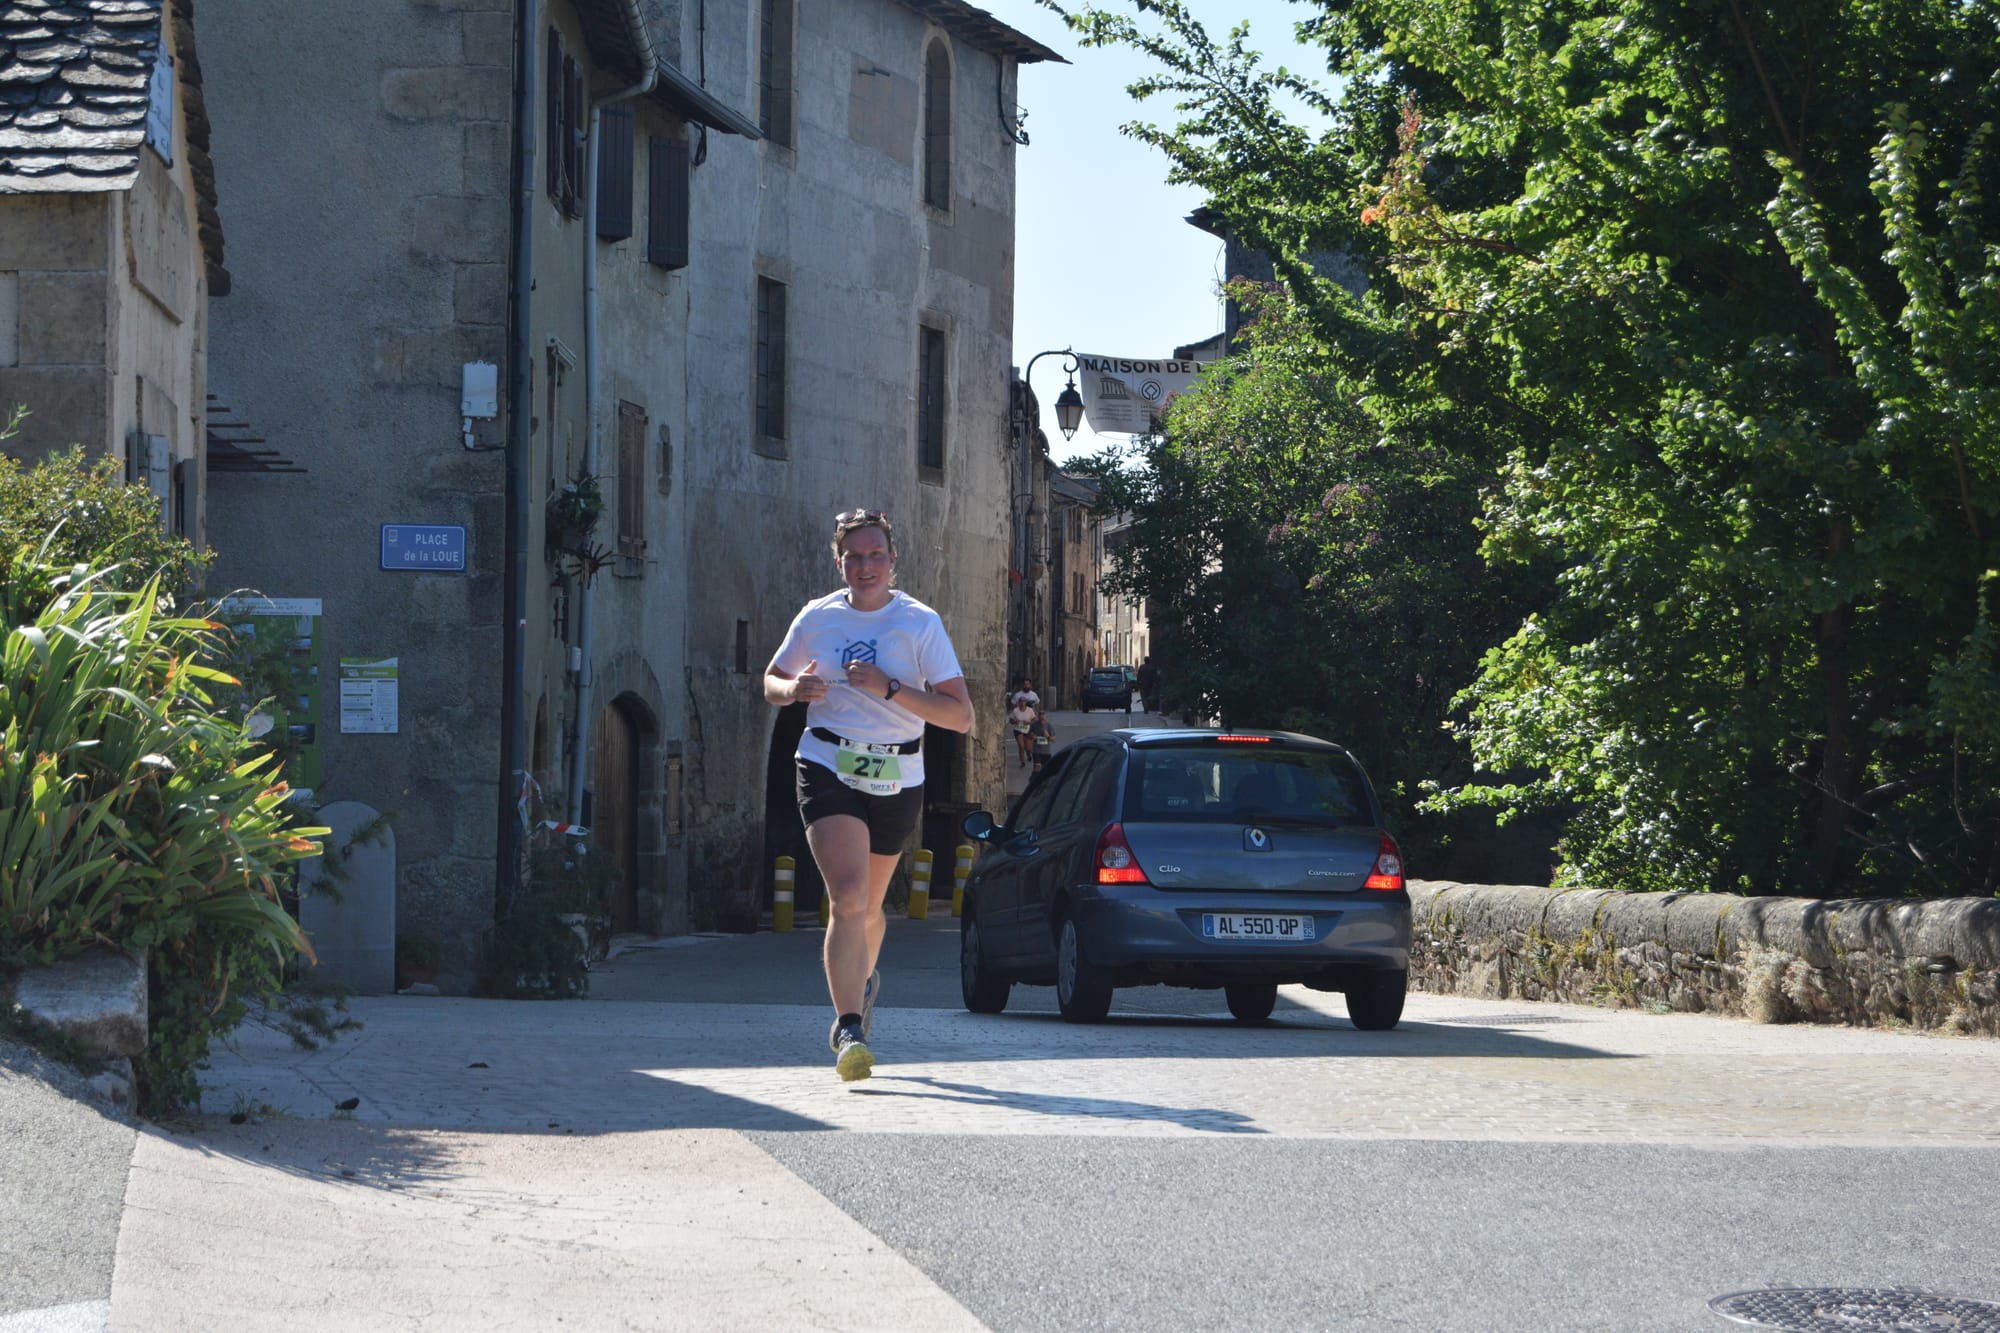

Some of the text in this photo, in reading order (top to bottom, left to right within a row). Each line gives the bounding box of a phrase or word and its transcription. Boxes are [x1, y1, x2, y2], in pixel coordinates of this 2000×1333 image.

[1083, 359, 1160, 373] MAISON
[1167, 362, 1191, 373] DE
[415, 534, 448, 545] PLACE
[404, 550, 459, 562] de la LOUE
[854, 756, 886, 778] 27
[1159, 864, 1181, 873] Clio
[1303, 927, 1313, 937] 35
